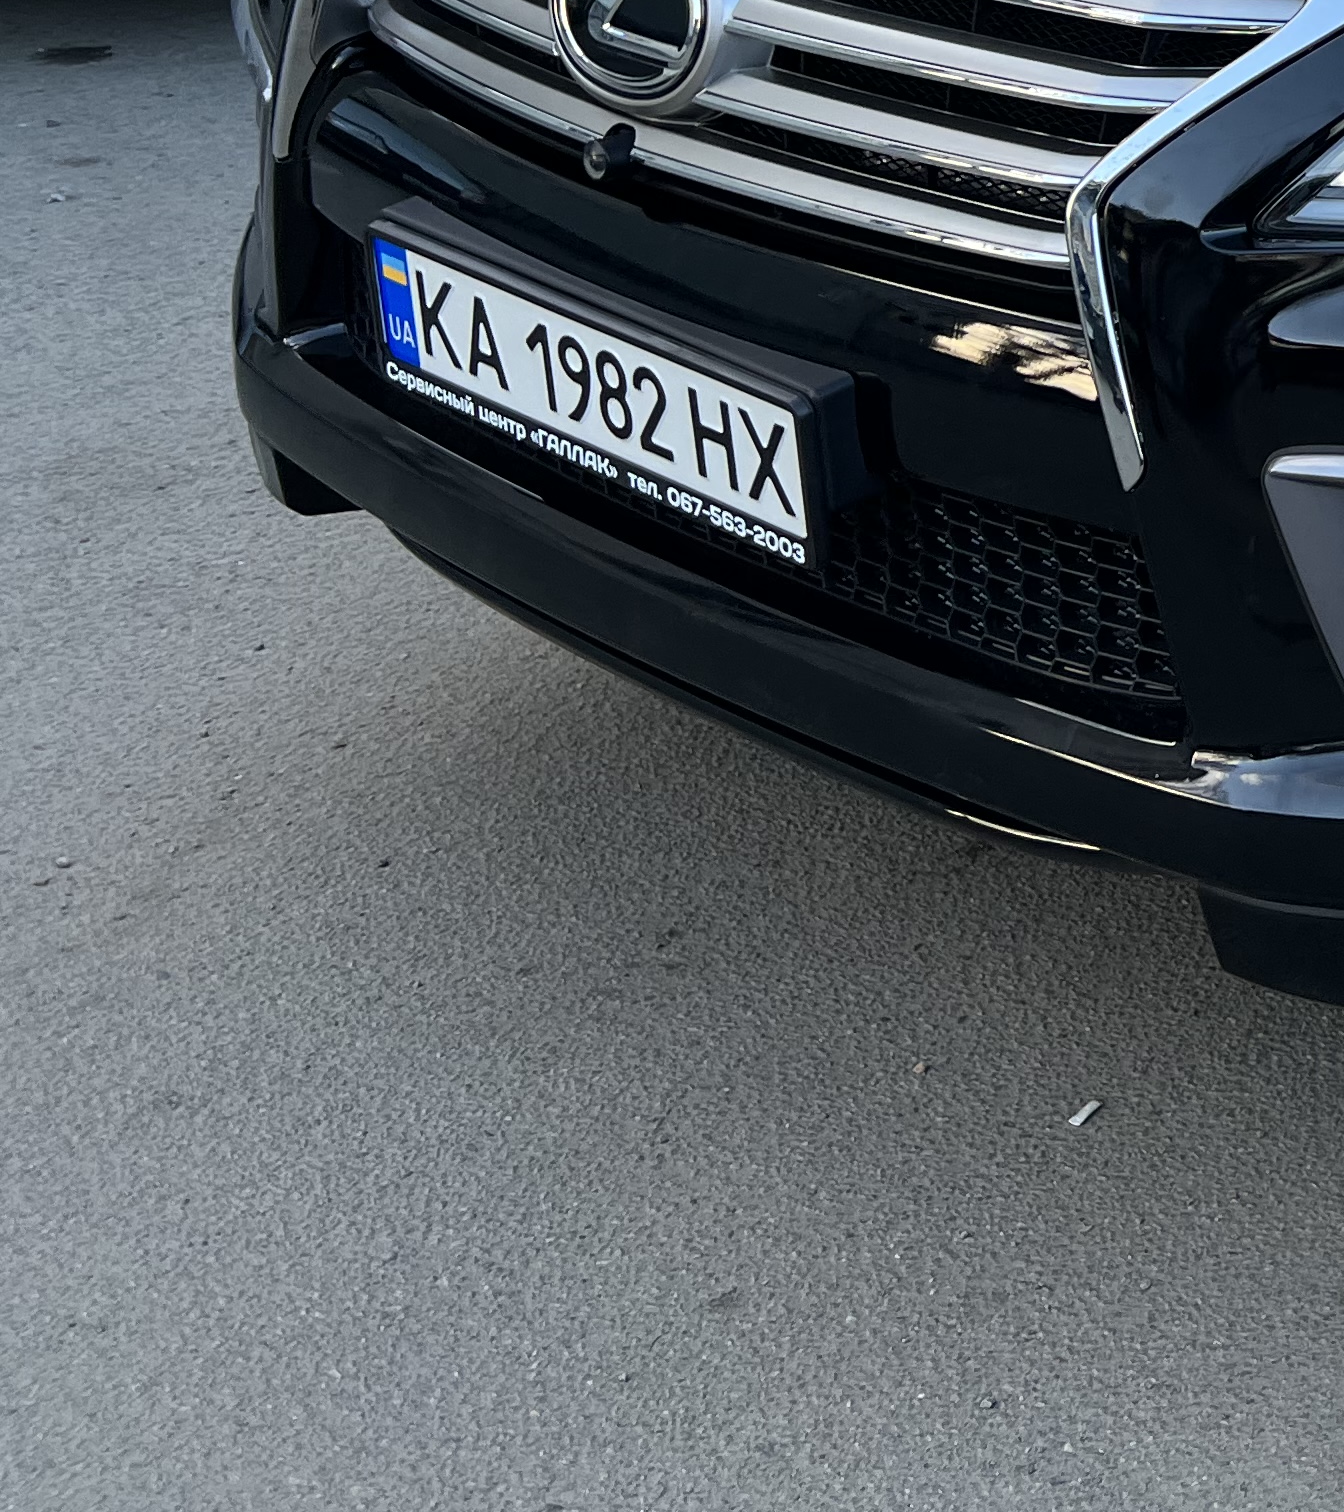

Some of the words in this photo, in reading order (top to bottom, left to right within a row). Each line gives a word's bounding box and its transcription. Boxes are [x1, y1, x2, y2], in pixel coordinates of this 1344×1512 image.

[388, 313, 416, 349] UA
[415, 269, 510, 391] KA
[525, 322, 675, 463] 1982
[385, 360, 475, 417] Сервисный
[478, 402, 527, 440] центр
[627, 471, 663, 501] тел.
[667, 486, 806, 565] 067-563-2003
